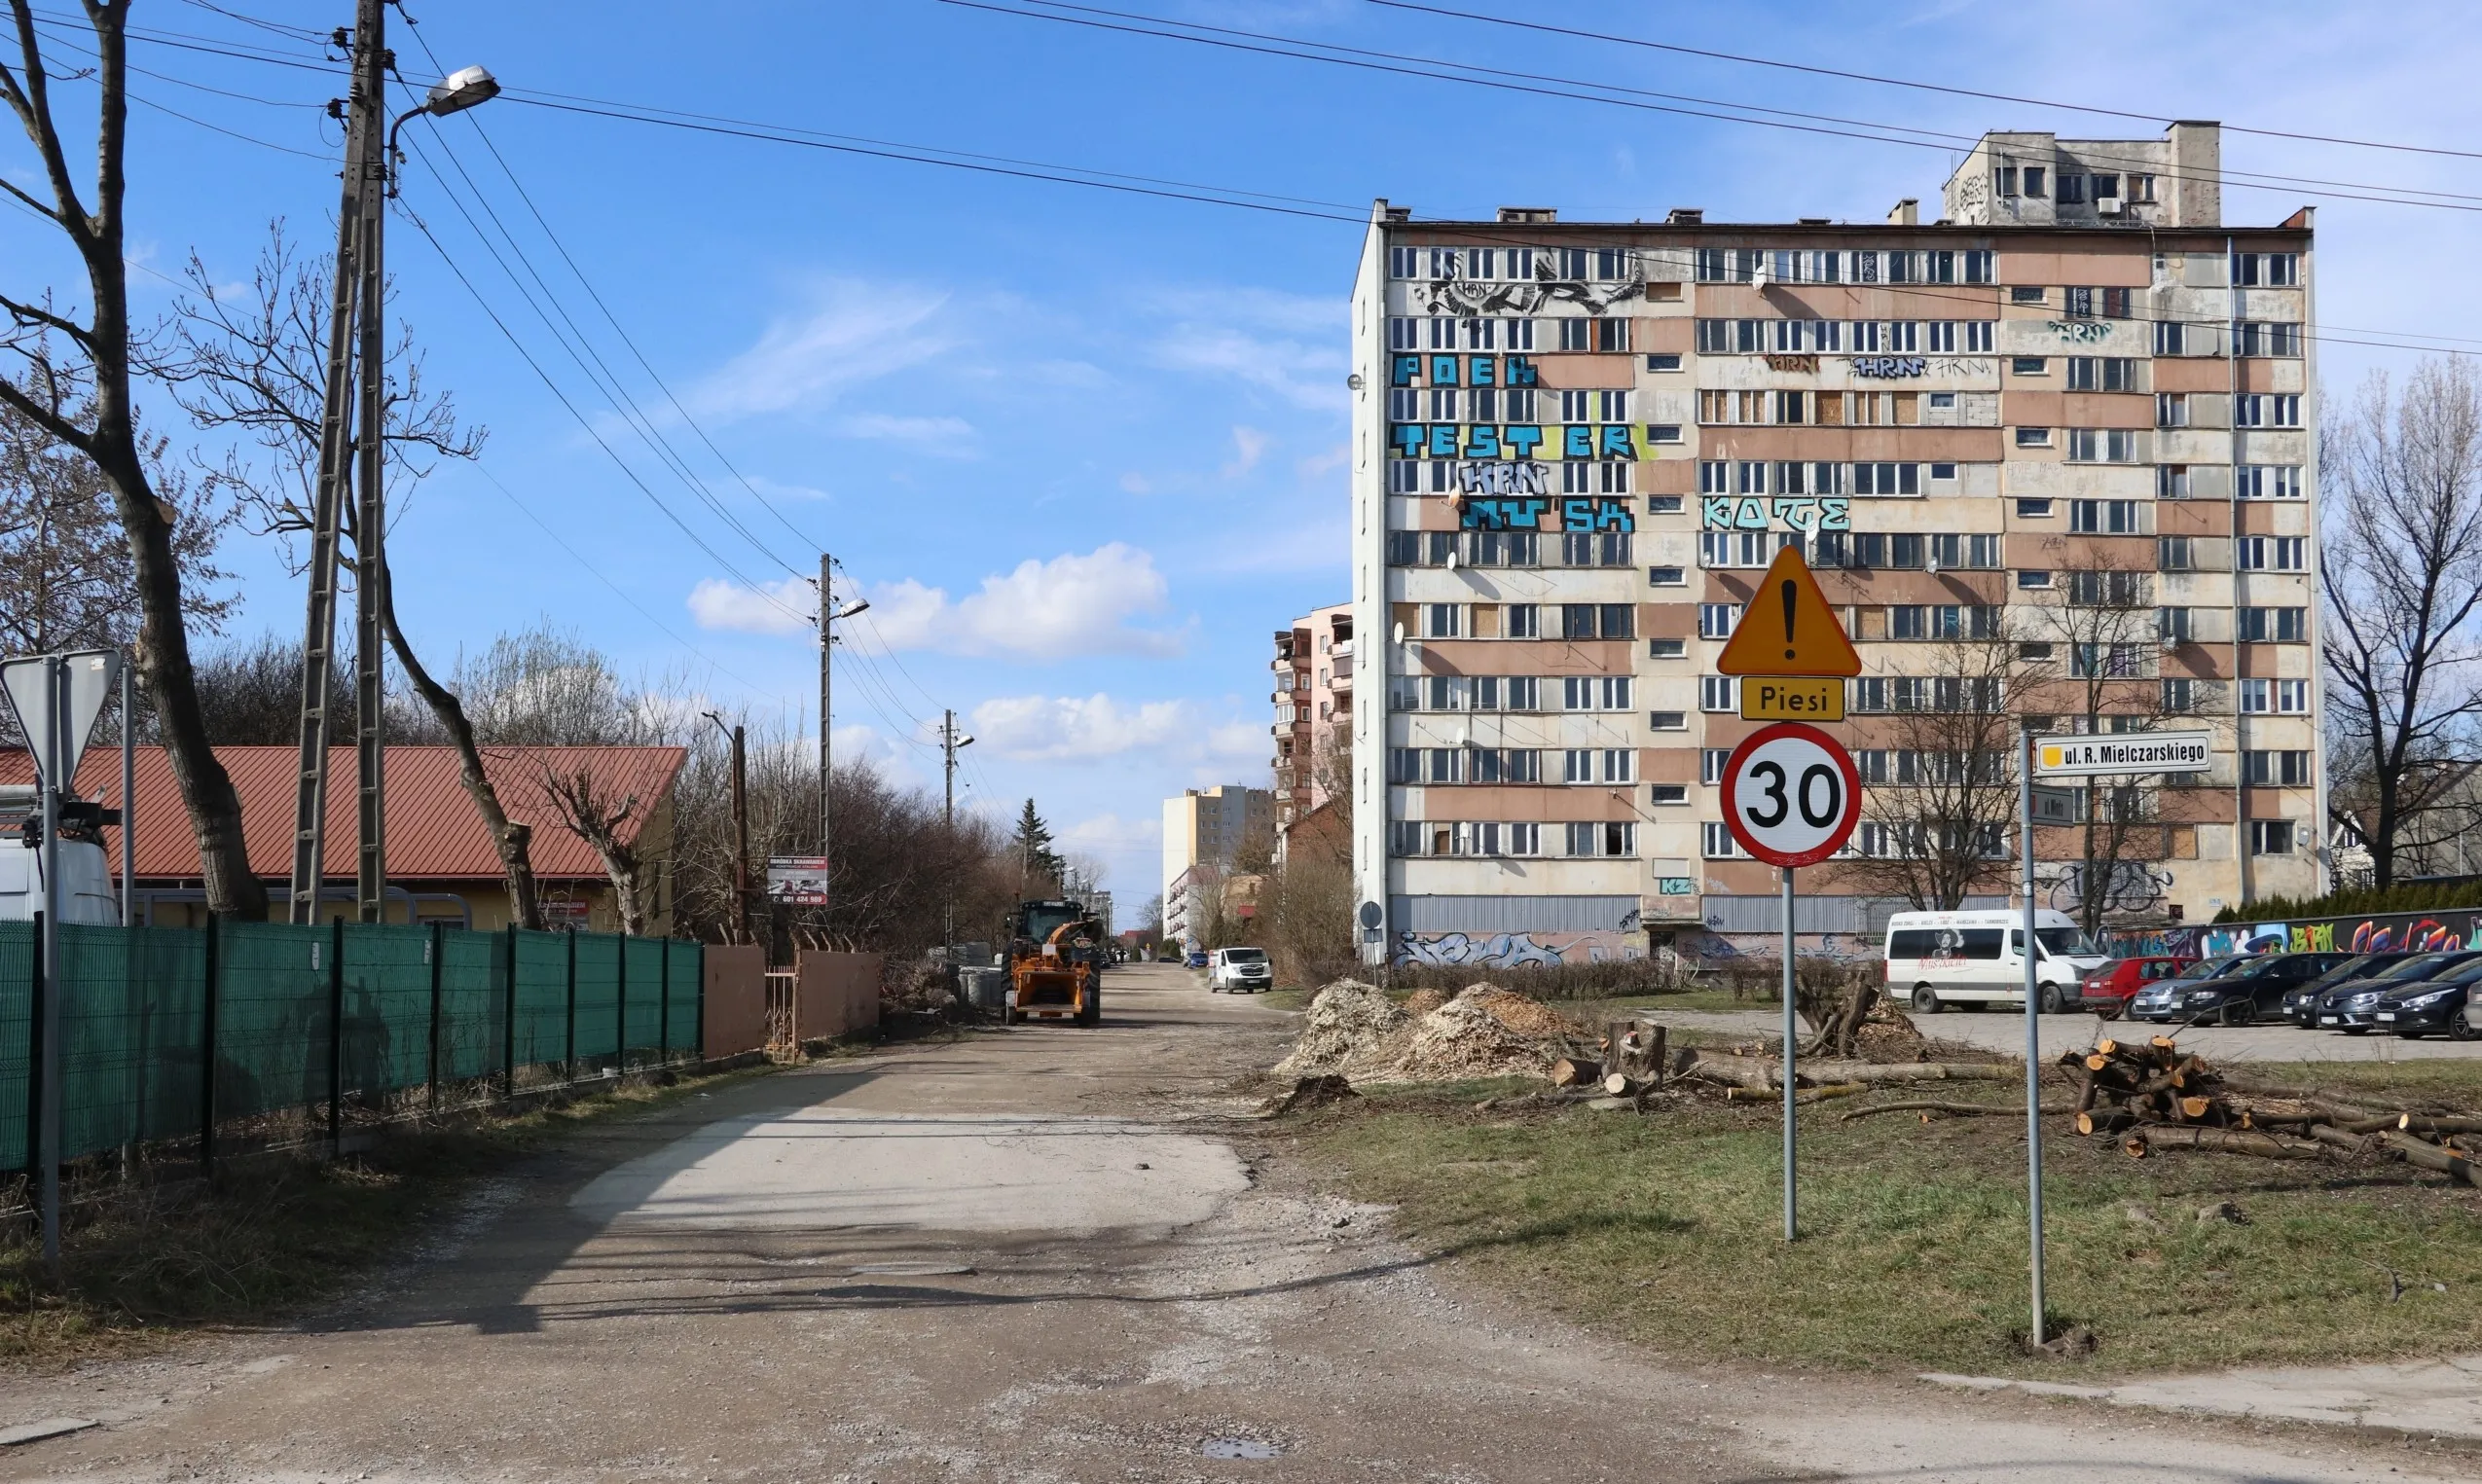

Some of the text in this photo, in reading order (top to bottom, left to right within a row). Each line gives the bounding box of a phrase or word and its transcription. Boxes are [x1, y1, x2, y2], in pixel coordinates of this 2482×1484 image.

[1852, 355, 1926, 380] HRN
[1761, 686, 1827, 711] Piesi
[2064, 742, 2205, 765] ul. R. Mielczarskiego
[1746, 760, 1841, 828] 30
